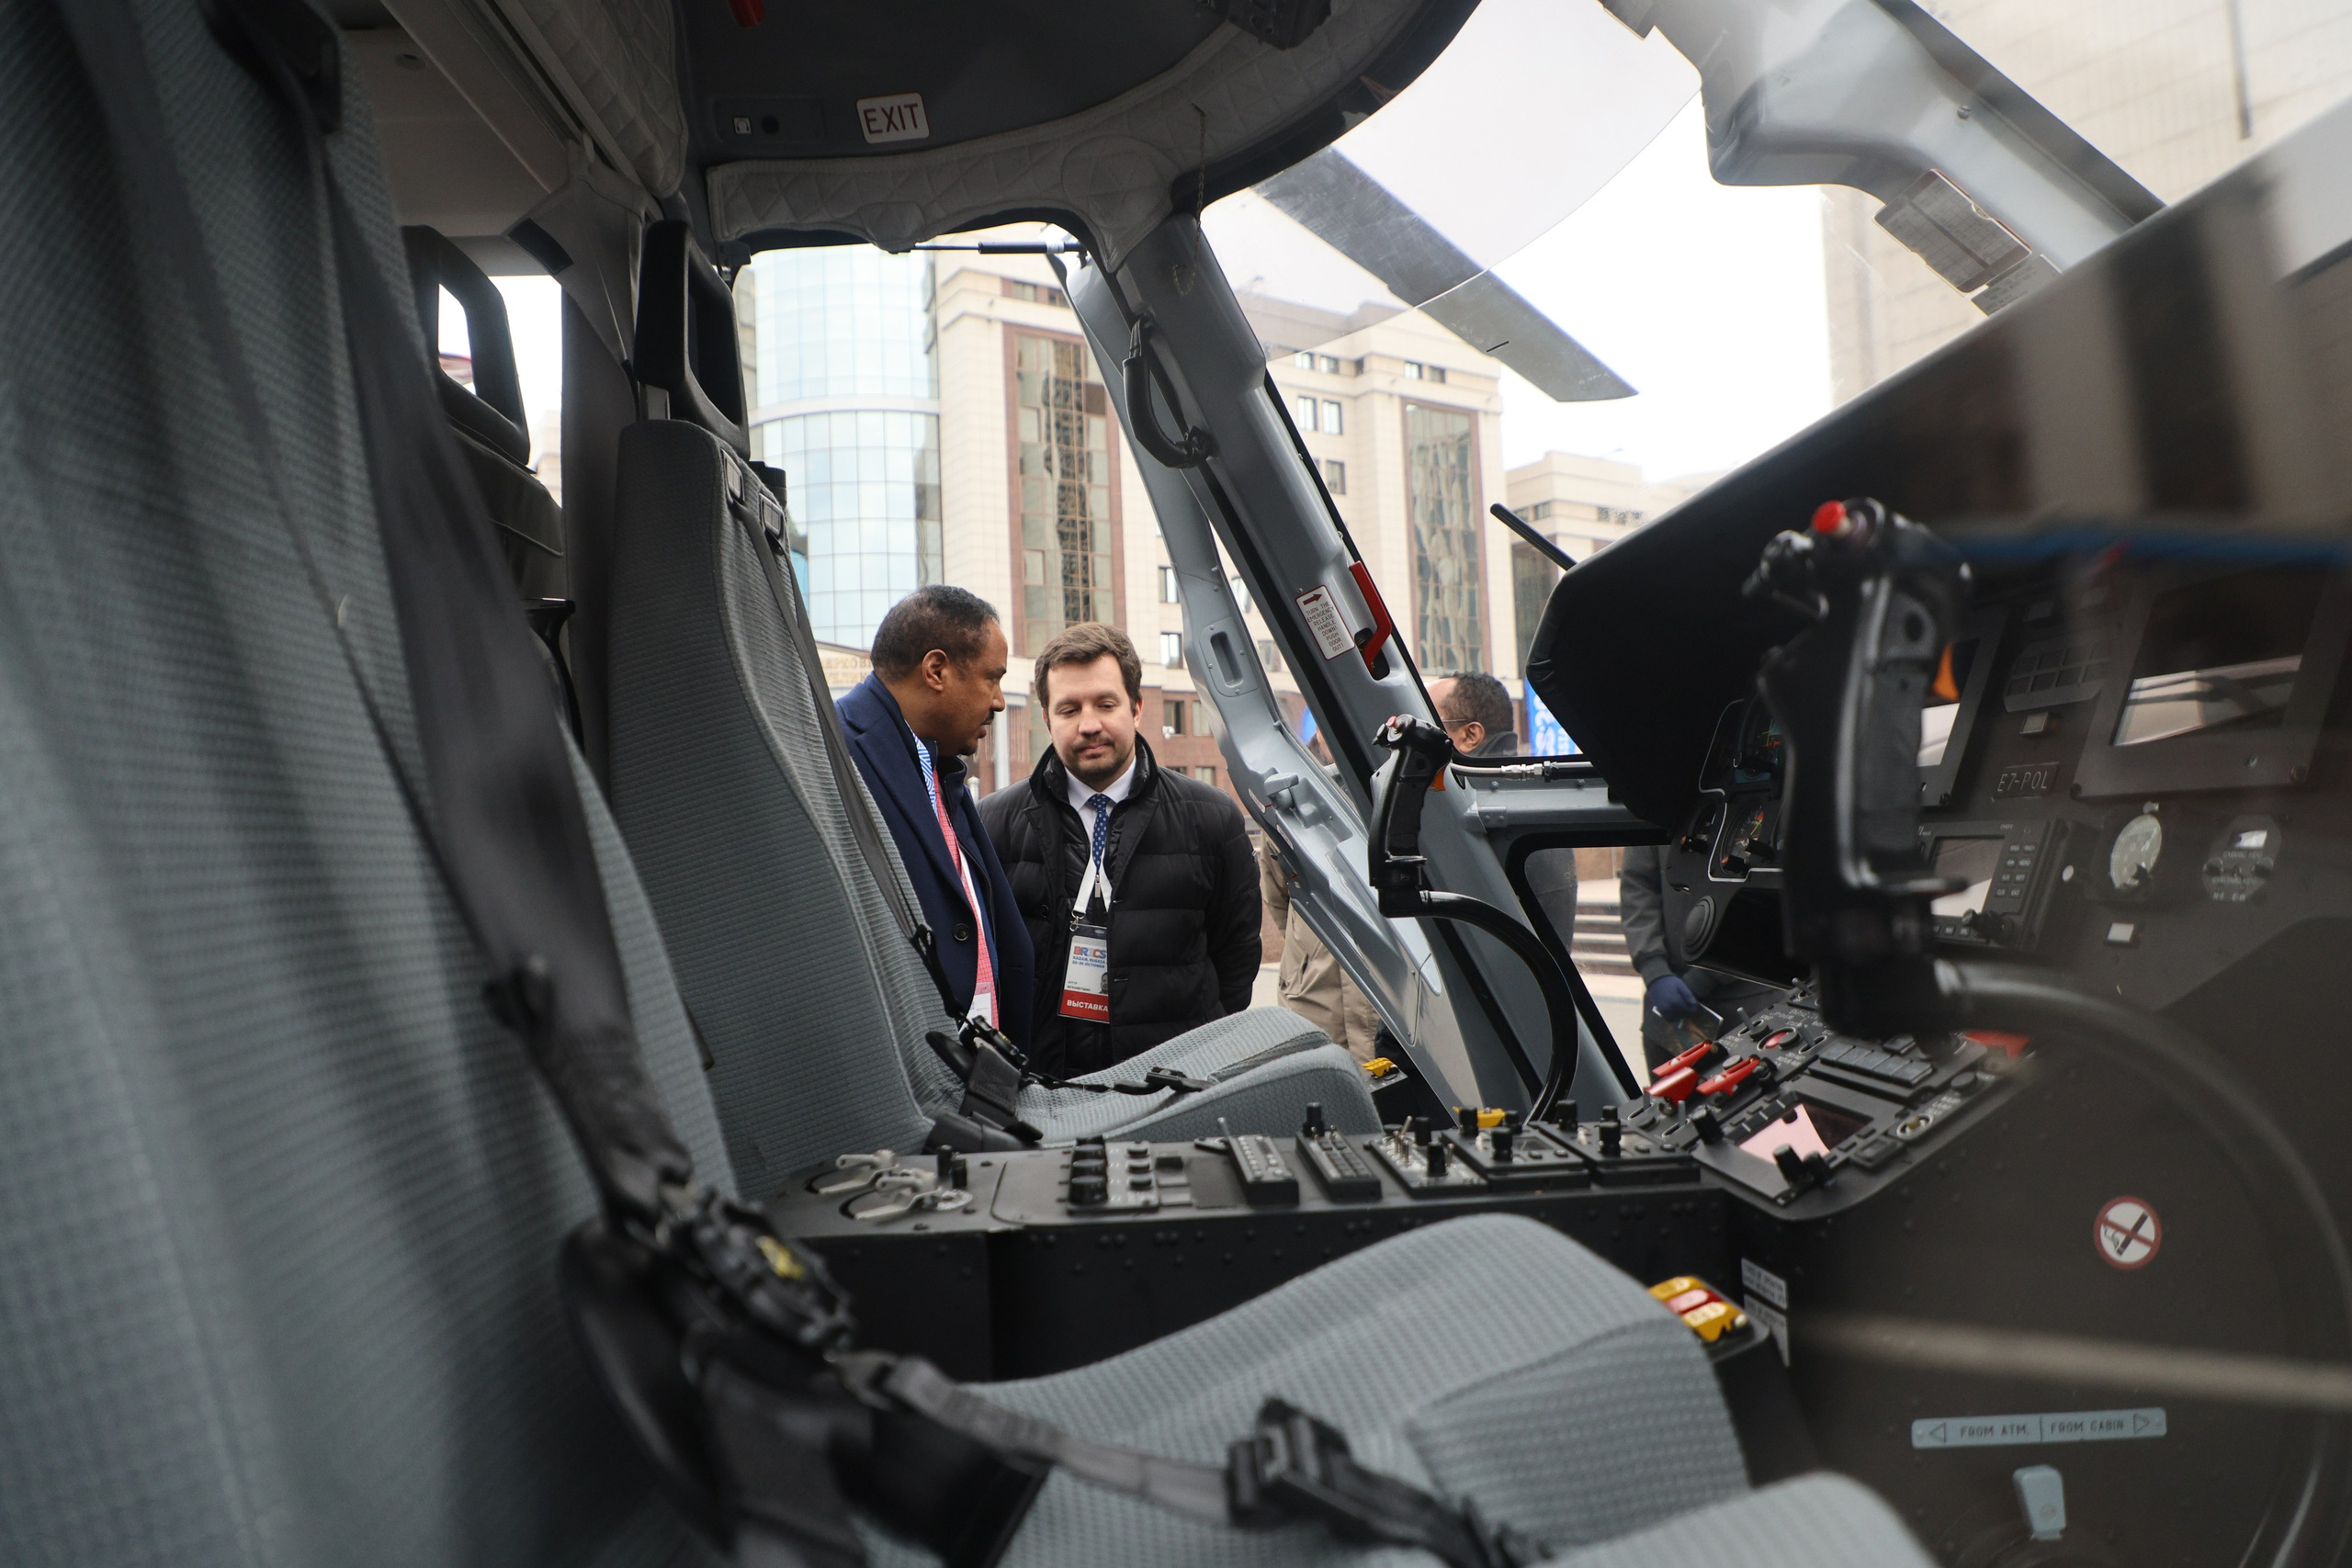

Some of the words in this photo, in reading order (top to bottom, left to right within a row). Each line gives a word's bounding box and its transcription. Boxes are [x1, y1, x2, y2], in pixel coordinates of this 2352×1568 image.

[863, 103, 919, 134] EXIT
[1306, 607, 1318, 615] TURN
[1306, 605, 1334, 623] EMERGENCY
[1313, 614, 1334, 626] RELEASE
[1317, 619, 1336, 631] HANDLE
[1326, 632, 1339, 641] PUSH
[1329, 637, 1341, 647] DOOR
[1332, 643, 1344, 652] OUT!
[1996, 770, 2048, 792] E7-POL
[1073, 945, 1106, 959] BRICS
[1067, 999, 1108, 1012] ВЫСТАВКА
[1960, 1426, 1994, 1438] FROM
[2051, 1422, 2084, 1434] FROM
[2090, 1419, 2124, 1432] CABIN
